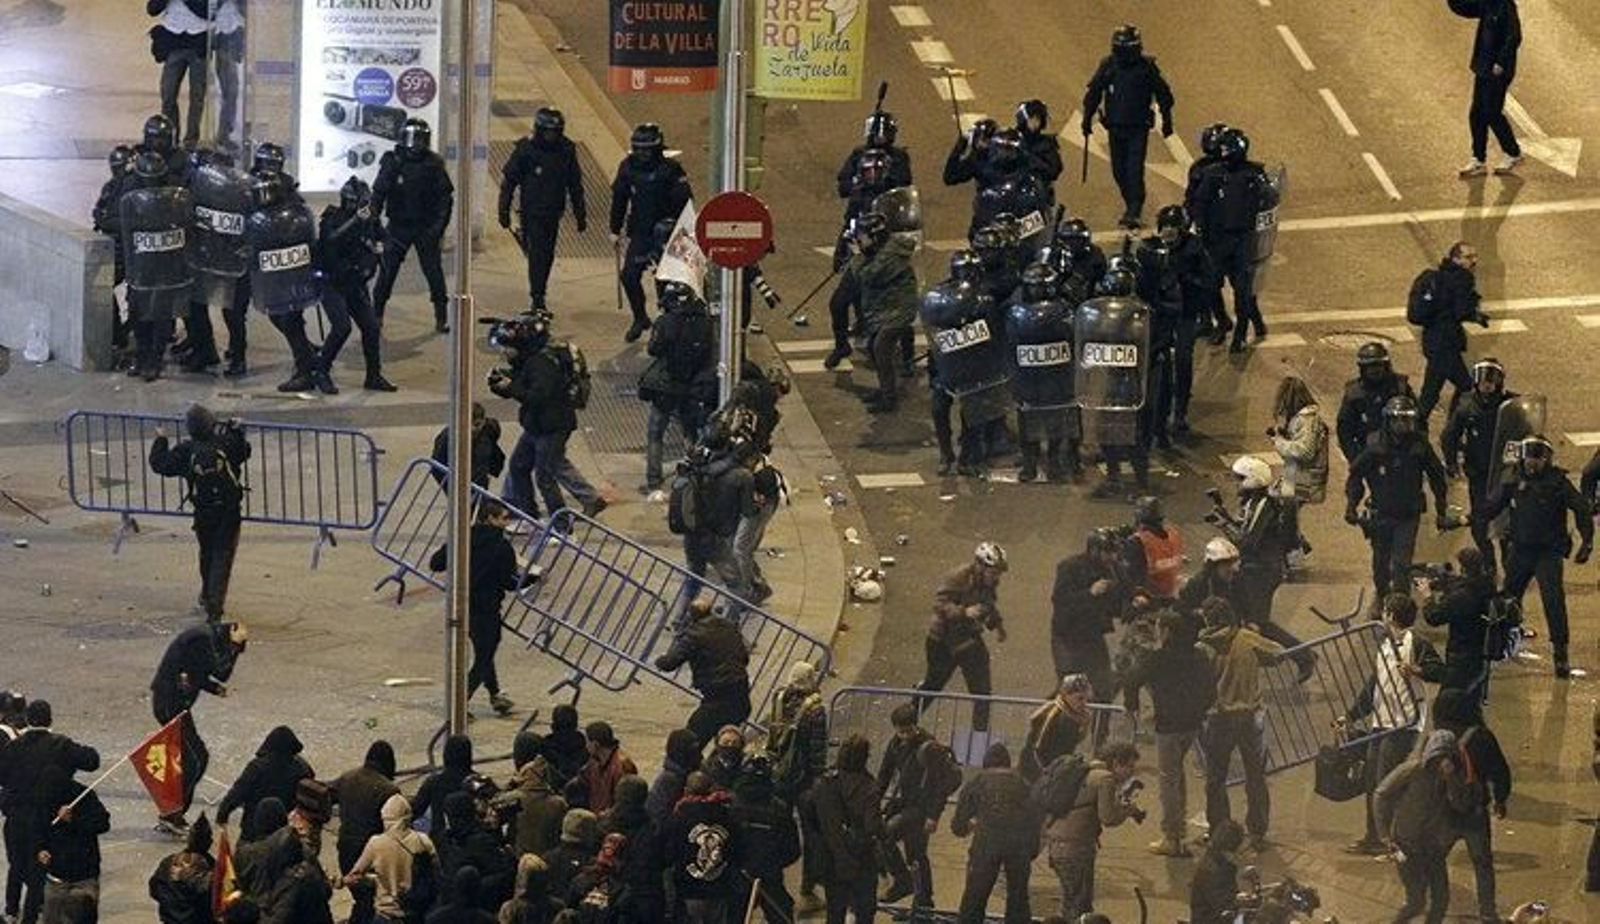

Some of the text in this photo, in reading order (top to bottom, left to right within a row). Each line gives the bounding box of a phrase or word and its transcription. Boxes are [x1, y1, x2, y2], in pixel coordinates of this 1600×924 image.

[359, 0, 432, 10] MUNDO
[621, 3, 708, 24] CULTURAL
[765, 0, 824, 22] RRE
[614, 31, 716, 55] DE LA VILLA
[763, 23, 801, 47] RO
[811, 32, 851, 53] Vida
[788, 42, 811, 61] de
[767, 55, 849, 83] Zarzuela
[653, 75, 692, 86] MADRID
[135, 230, 183, 249] POLICIA
[261, 246, 309, 268] POLICIA
[937, 324, 988, 350] POLICIA
[1018, 343, 1070, 363] POLICIA
[1085, 346, 1135, 363] POLICIA
